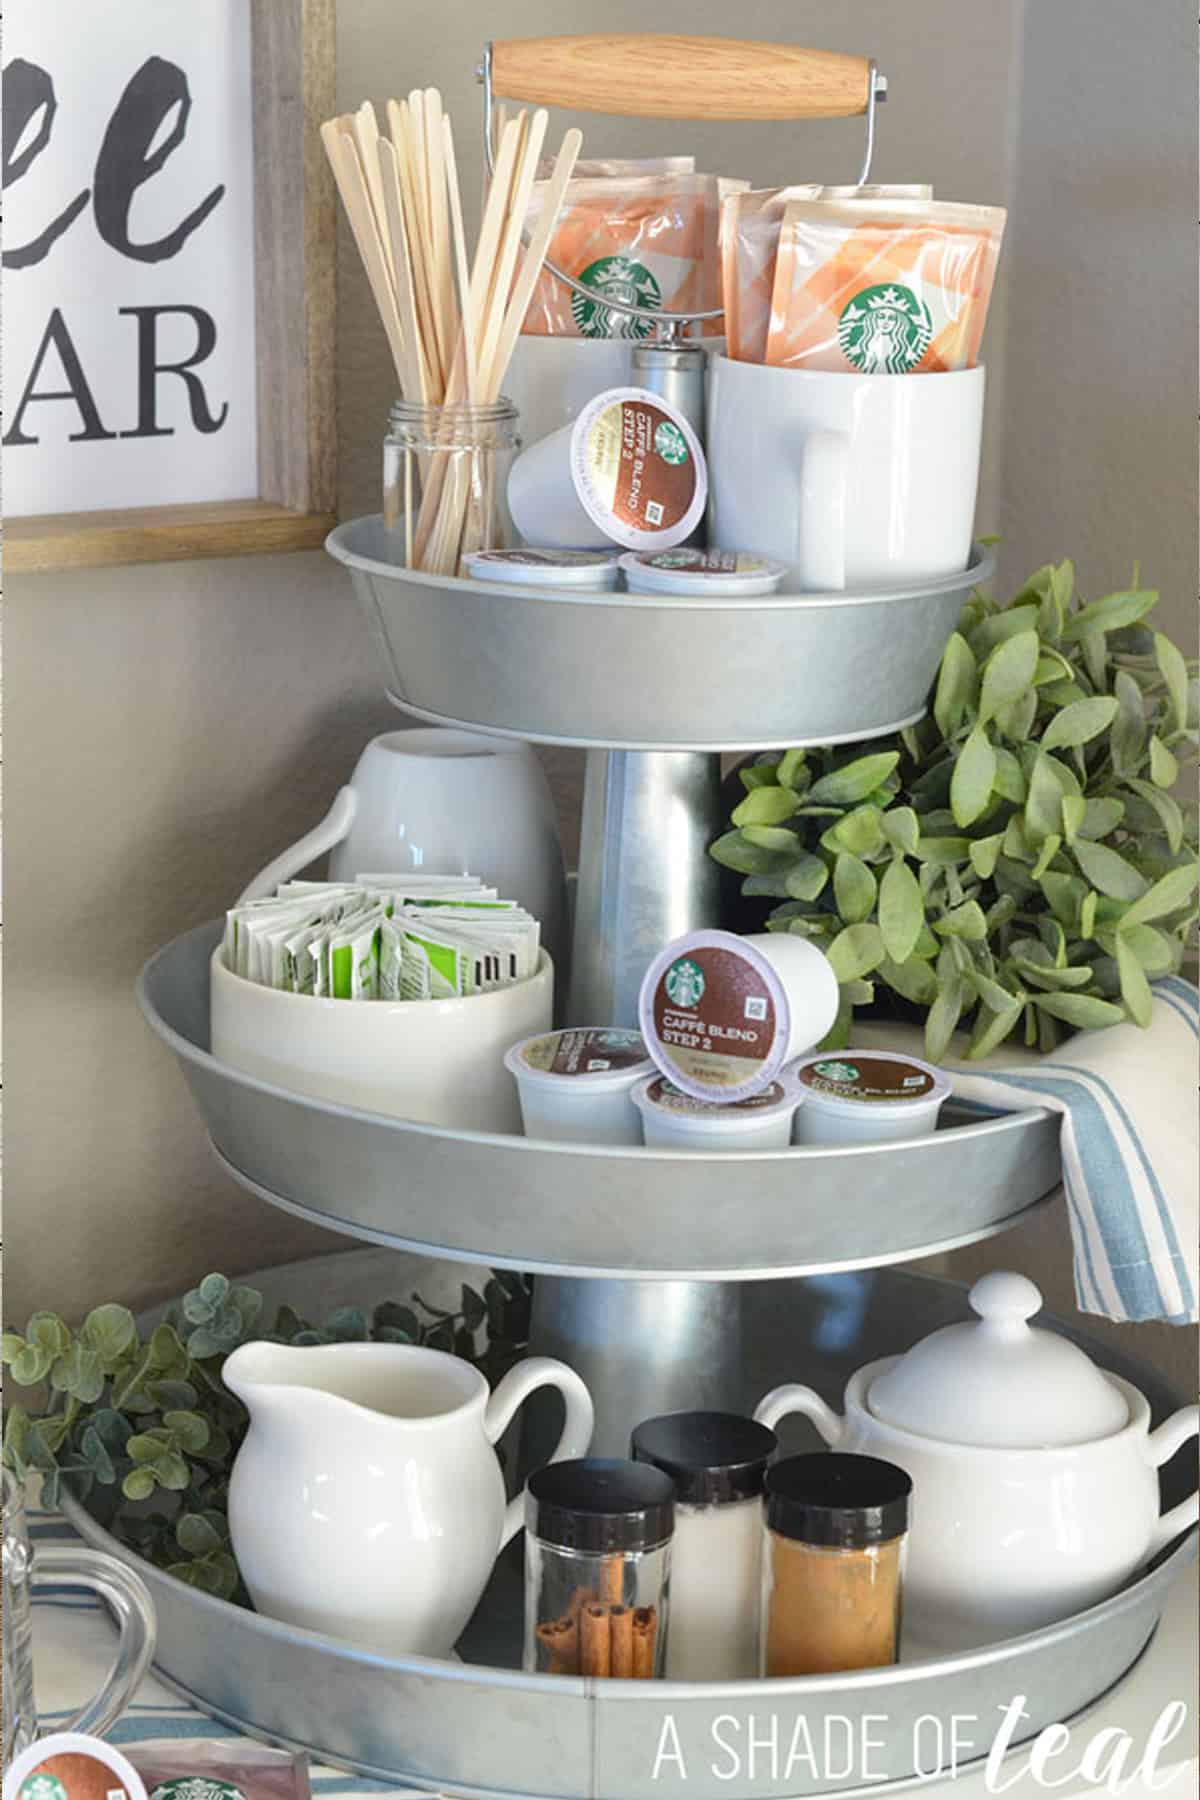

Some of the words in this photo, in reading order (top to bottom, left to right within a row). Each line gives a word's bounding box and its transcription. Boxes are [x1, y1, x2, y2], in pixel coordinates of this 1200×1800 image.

[2, 304, 228, 446] AR
[624, 408, 634, 449] STEP
[622, 449, 633, 460] 2
[628, 460, 644, 510] BLEND
[663, 1029, 700, 1047] STEP
[702, 1037, 713, 1051] 2
[708, 1024, 759, 1043] BLEND
